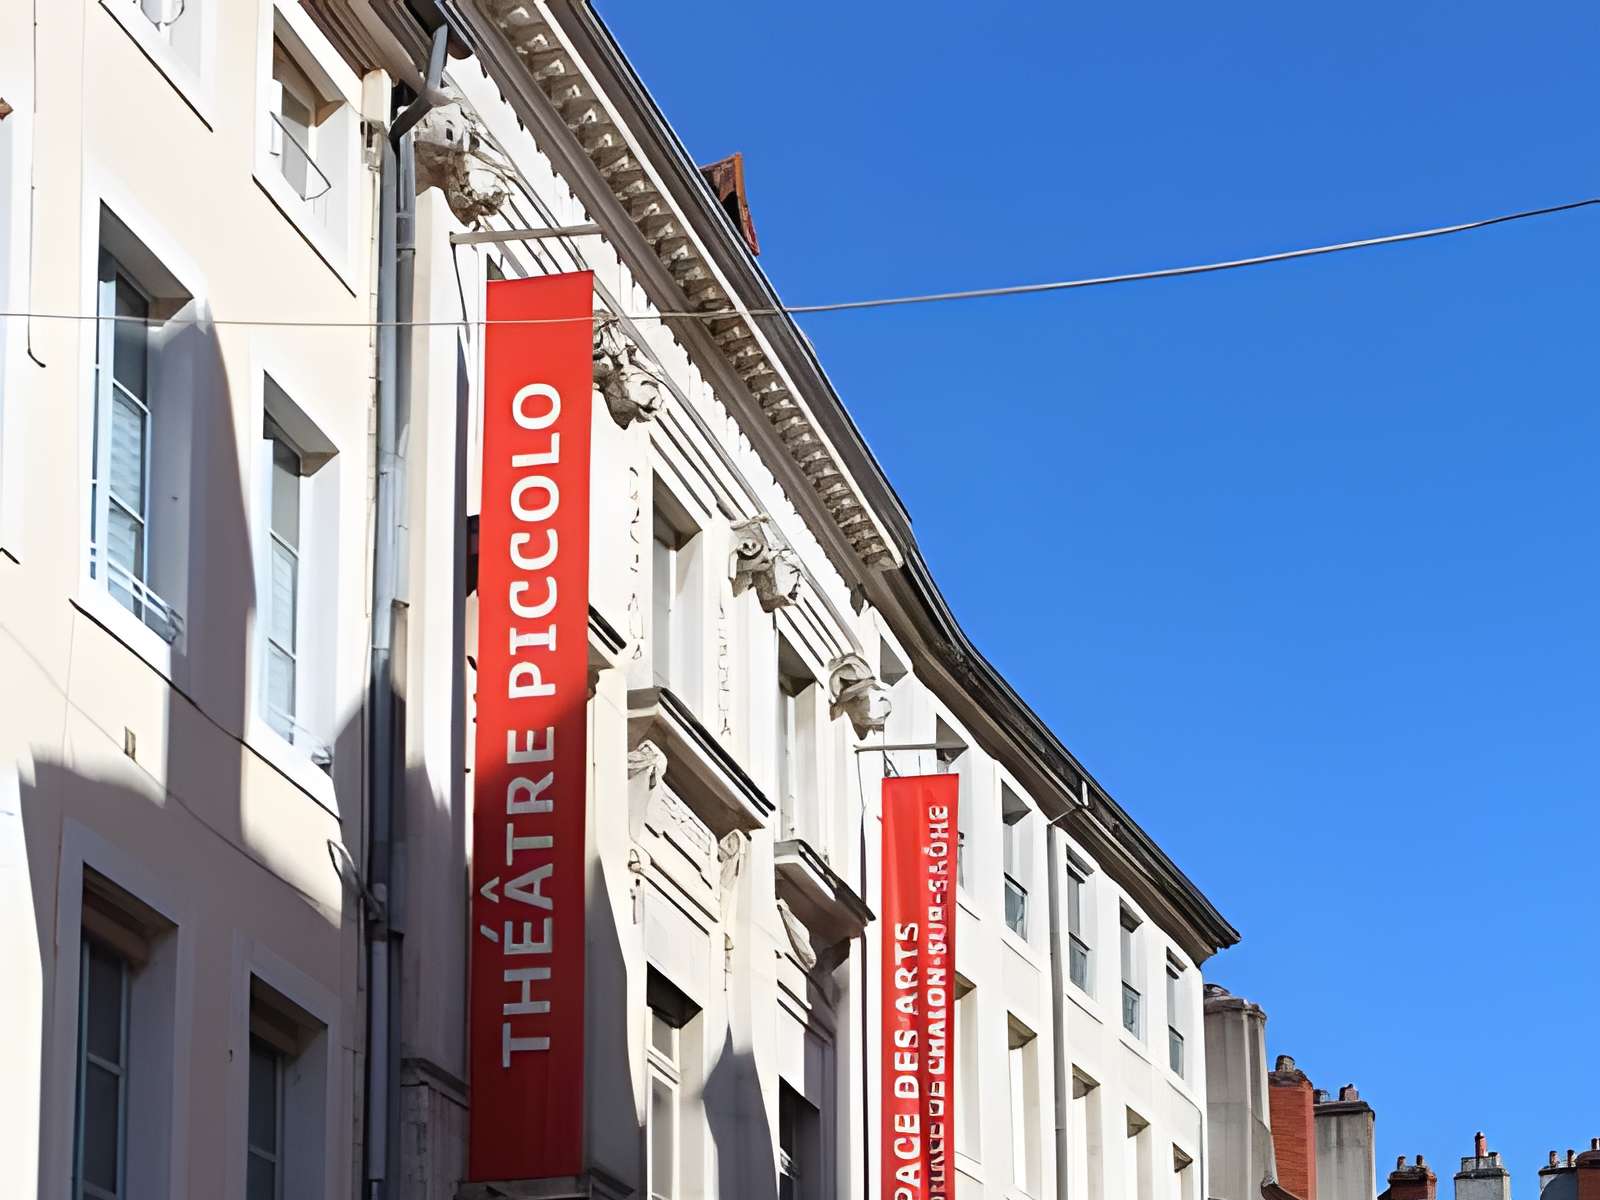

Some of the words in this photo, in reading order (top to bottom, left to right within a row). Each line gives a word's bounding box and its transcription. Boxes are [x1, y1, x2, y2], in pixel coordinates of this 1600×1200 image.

[507, 382, 562, 699] PICCOLO
[480, 725, 555, 1068] THÉÂTRE
[894, 922, 919, 1016] ARTS
[894, 1030, 920, 1099] DES
